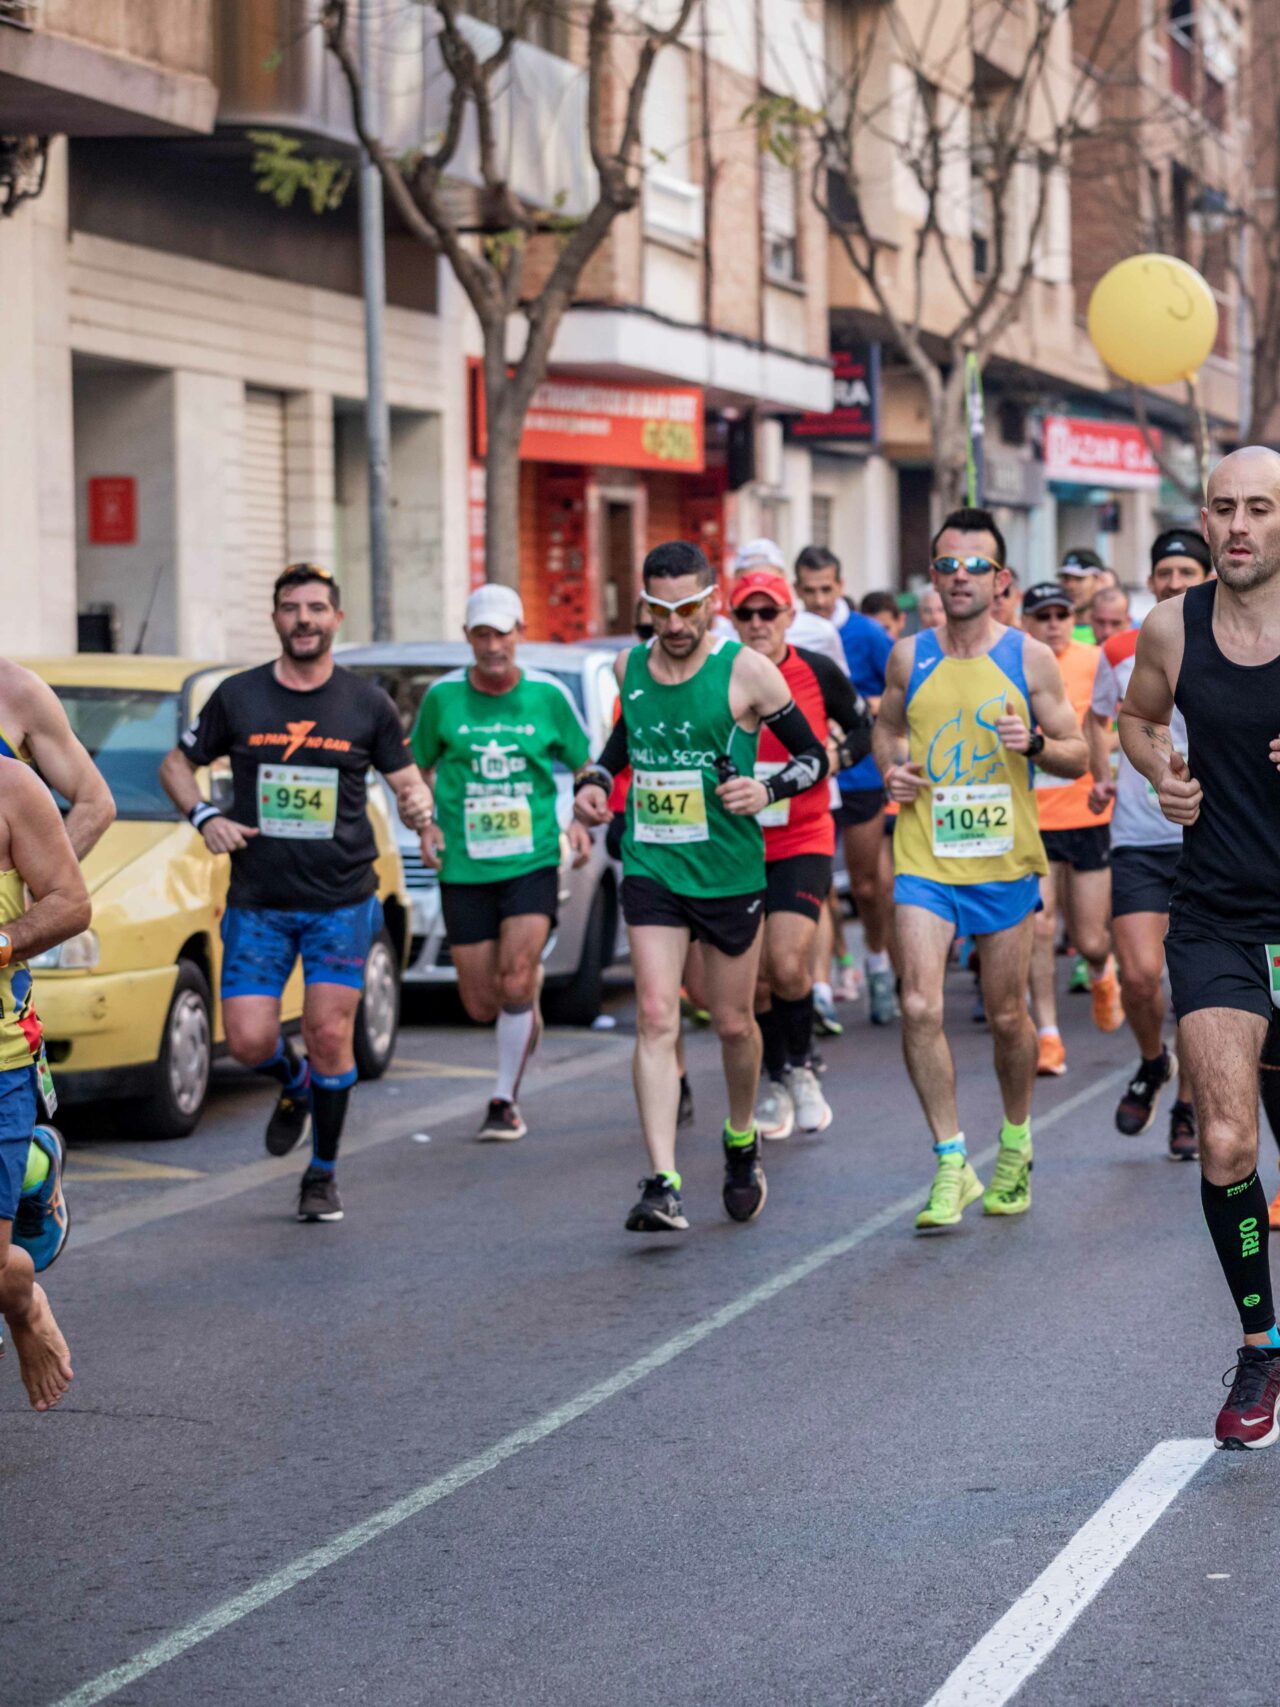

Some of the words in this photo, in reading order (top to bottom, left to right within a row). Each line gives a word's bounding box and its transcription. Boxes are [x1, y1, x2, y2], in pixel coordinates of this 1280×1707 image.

[304, 737, 323, 748] NO
[276, 787, 322, 810] 954
[647, 793, 689, 815] 847
[481, 811, 520, 832] 928
[945, 806, 1008, 830] 1042
